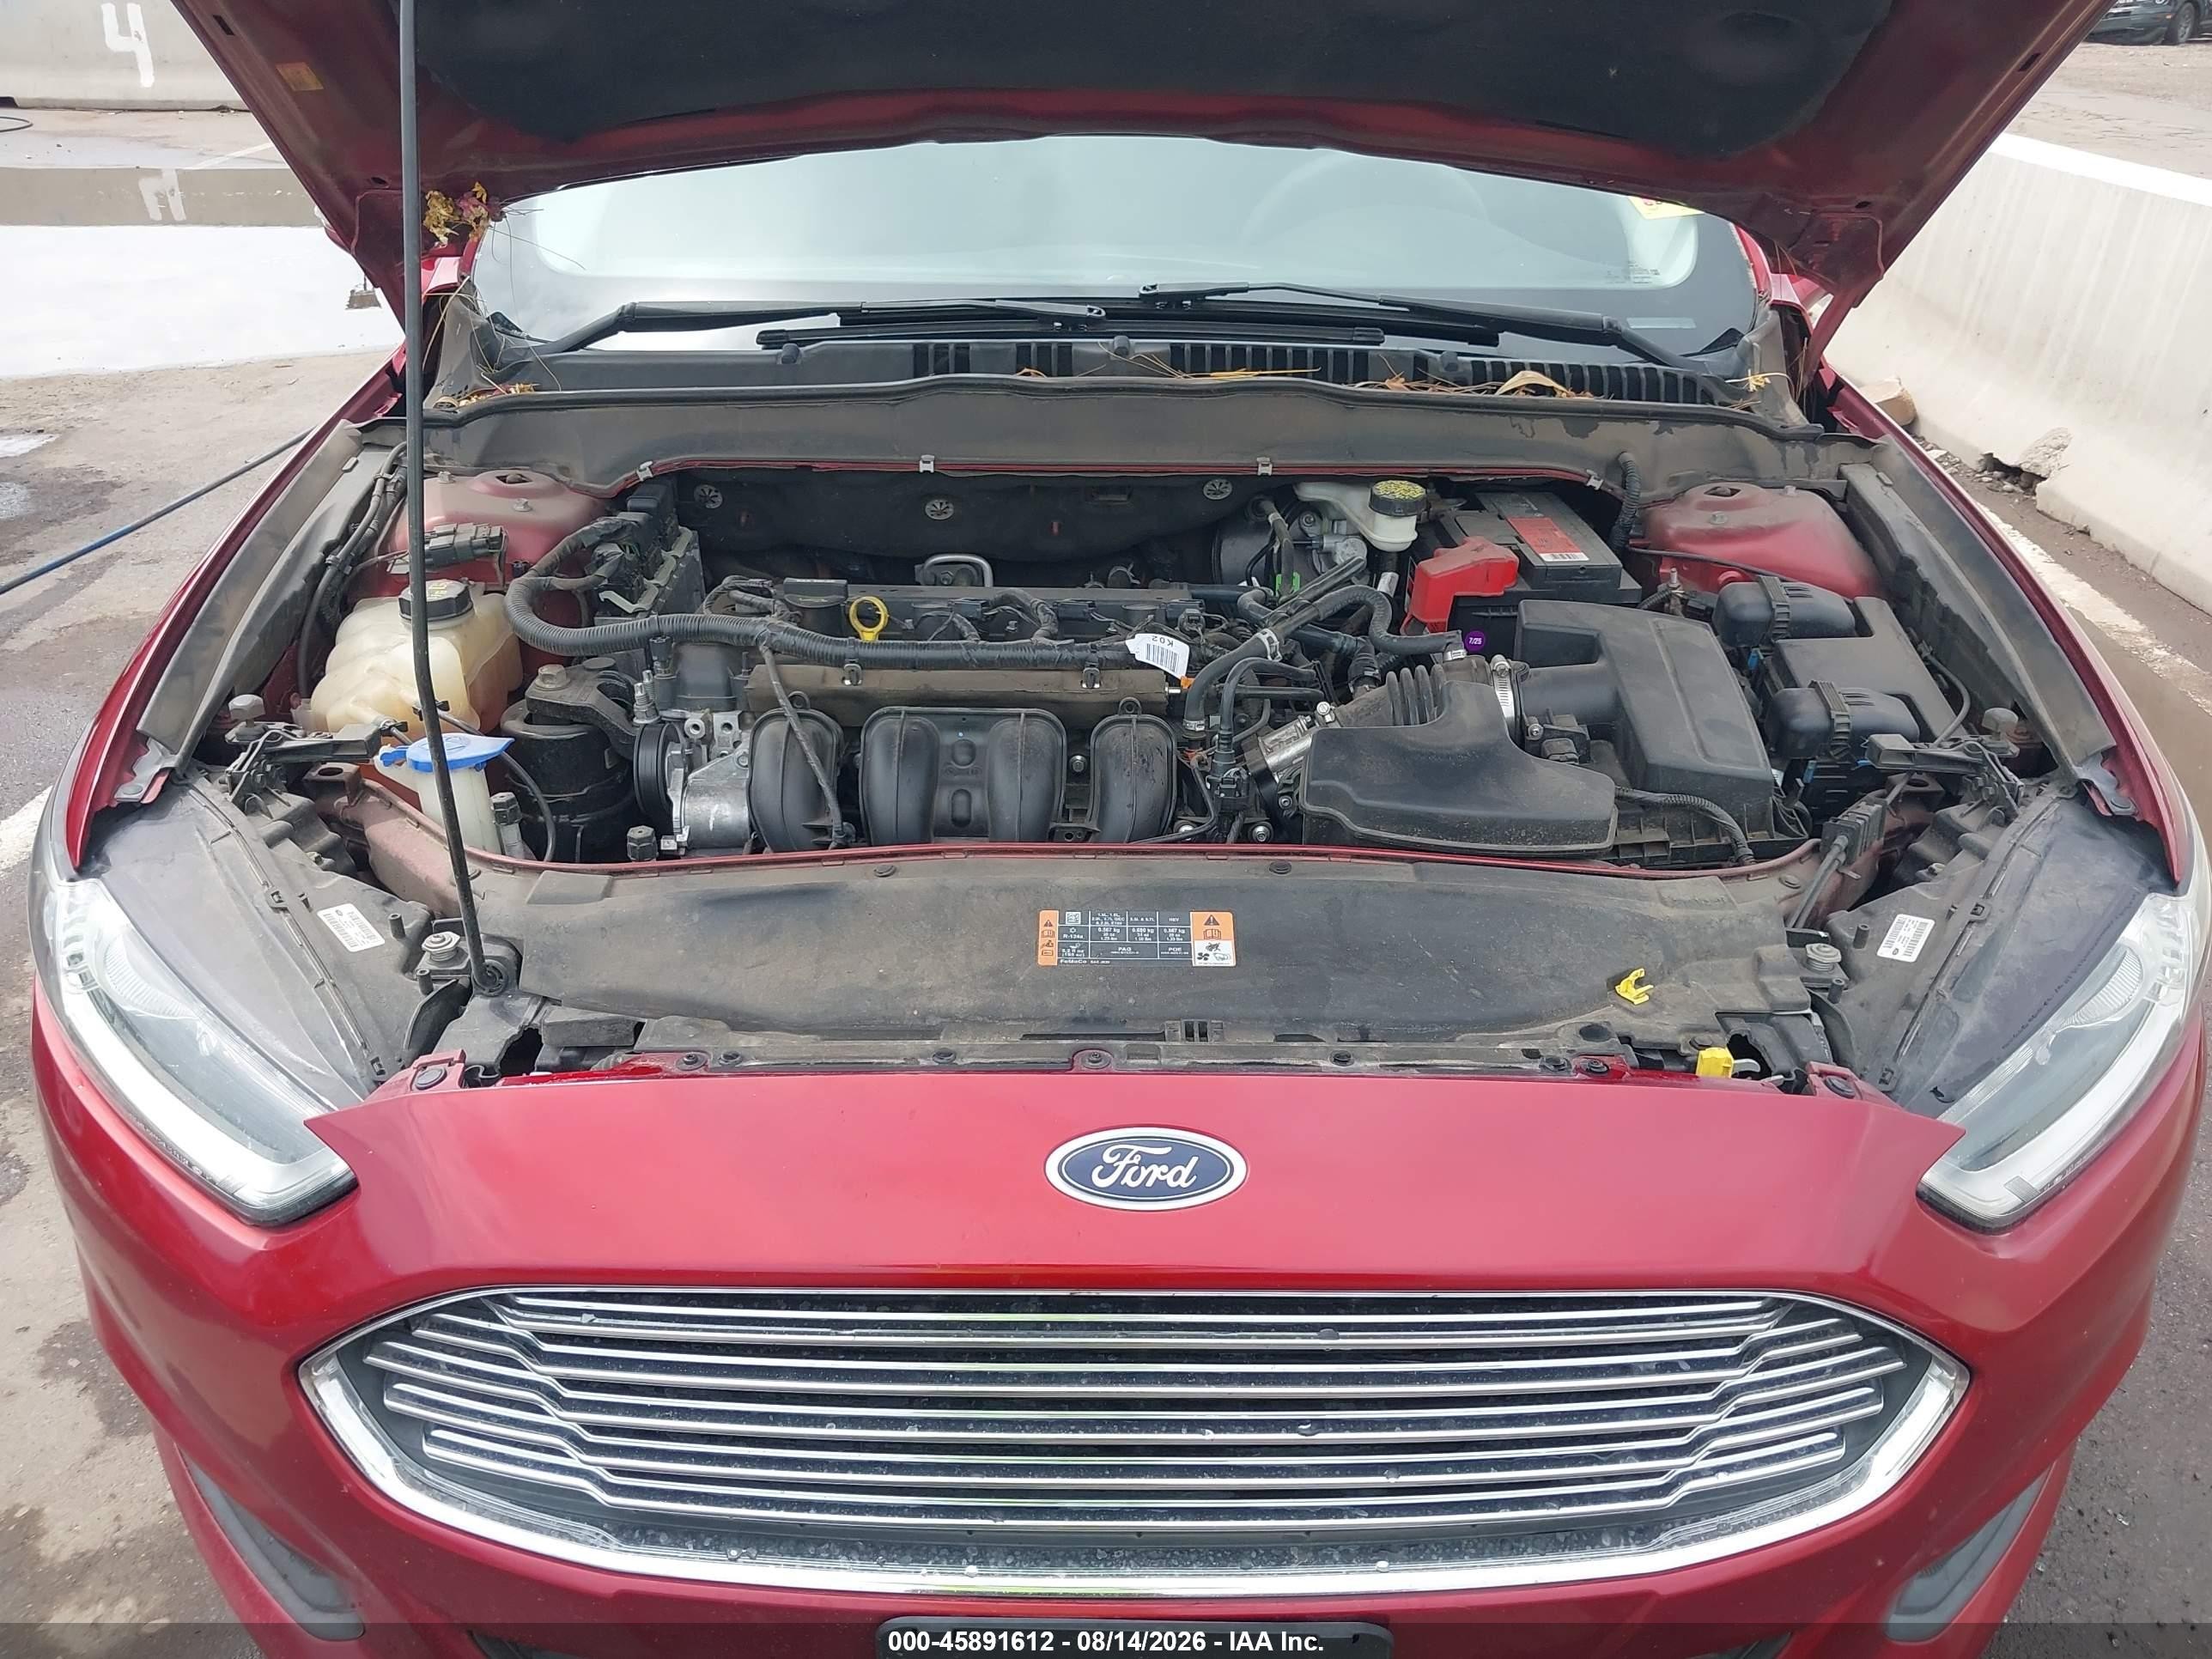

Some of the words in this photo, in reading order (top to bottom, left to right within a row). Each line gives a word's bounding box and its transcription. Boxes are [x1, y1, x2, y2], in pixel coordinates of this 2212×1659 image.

[100, 3, 155, 88] 4
[1152, 635, 1174, 647] K02
[1091, 1143, 1199, 1188] Ford
